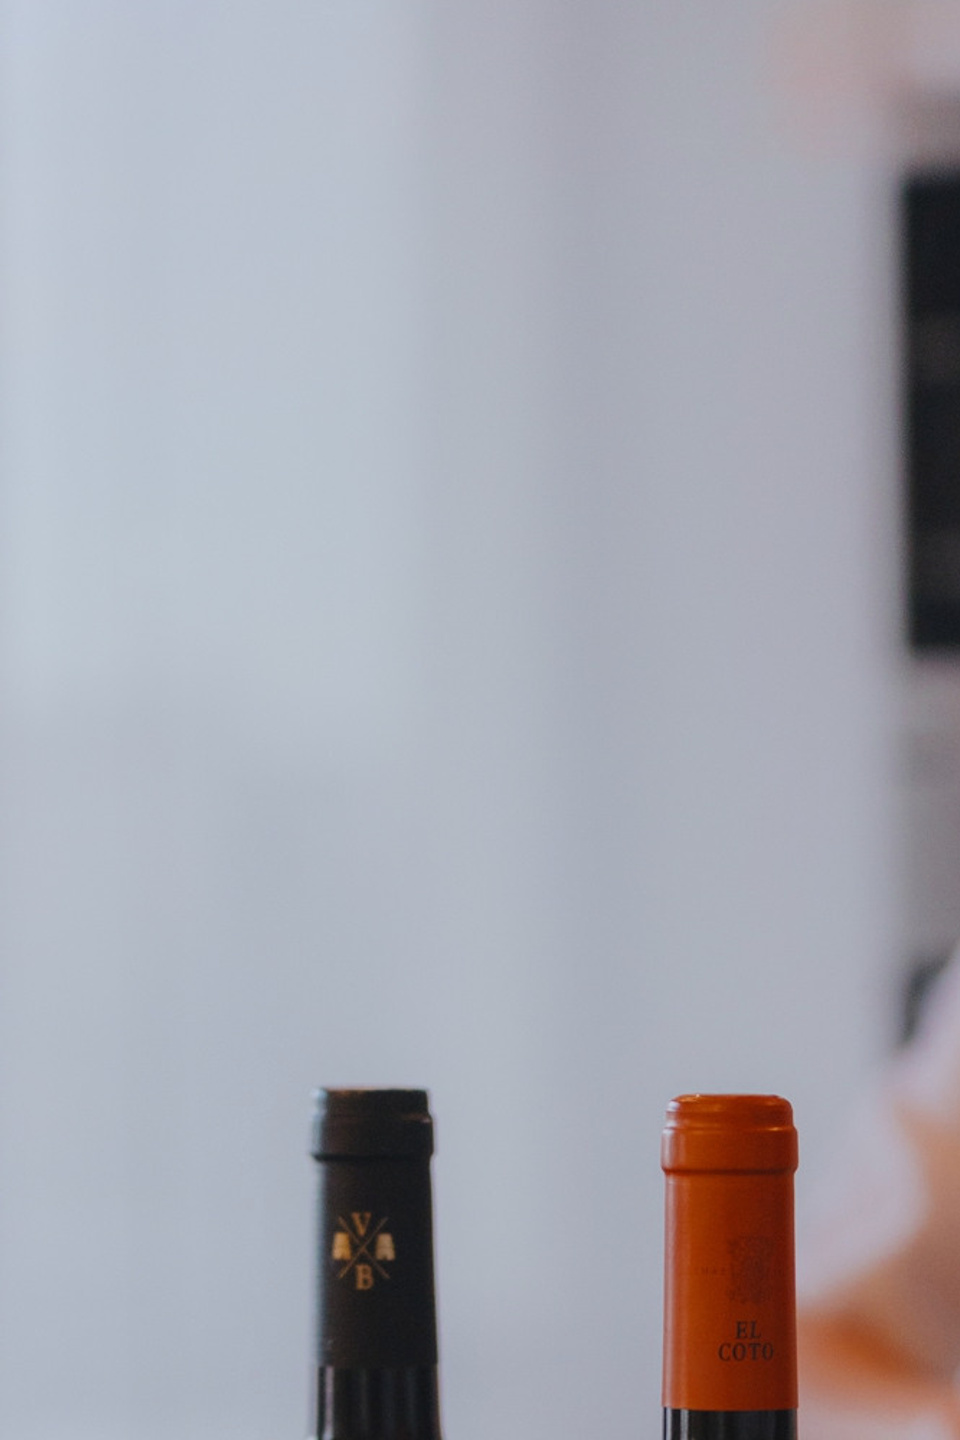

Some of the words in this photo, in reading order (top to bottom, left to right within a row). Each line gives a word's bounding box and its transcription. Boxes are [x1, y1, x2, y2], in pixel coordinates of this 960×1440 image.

[351, 1211, 372, 1237] V
[355, 1264, 374, 1291] B
[735, 1320, 761, 1340] EL
[718, 1342, 774, 1362] COTO
